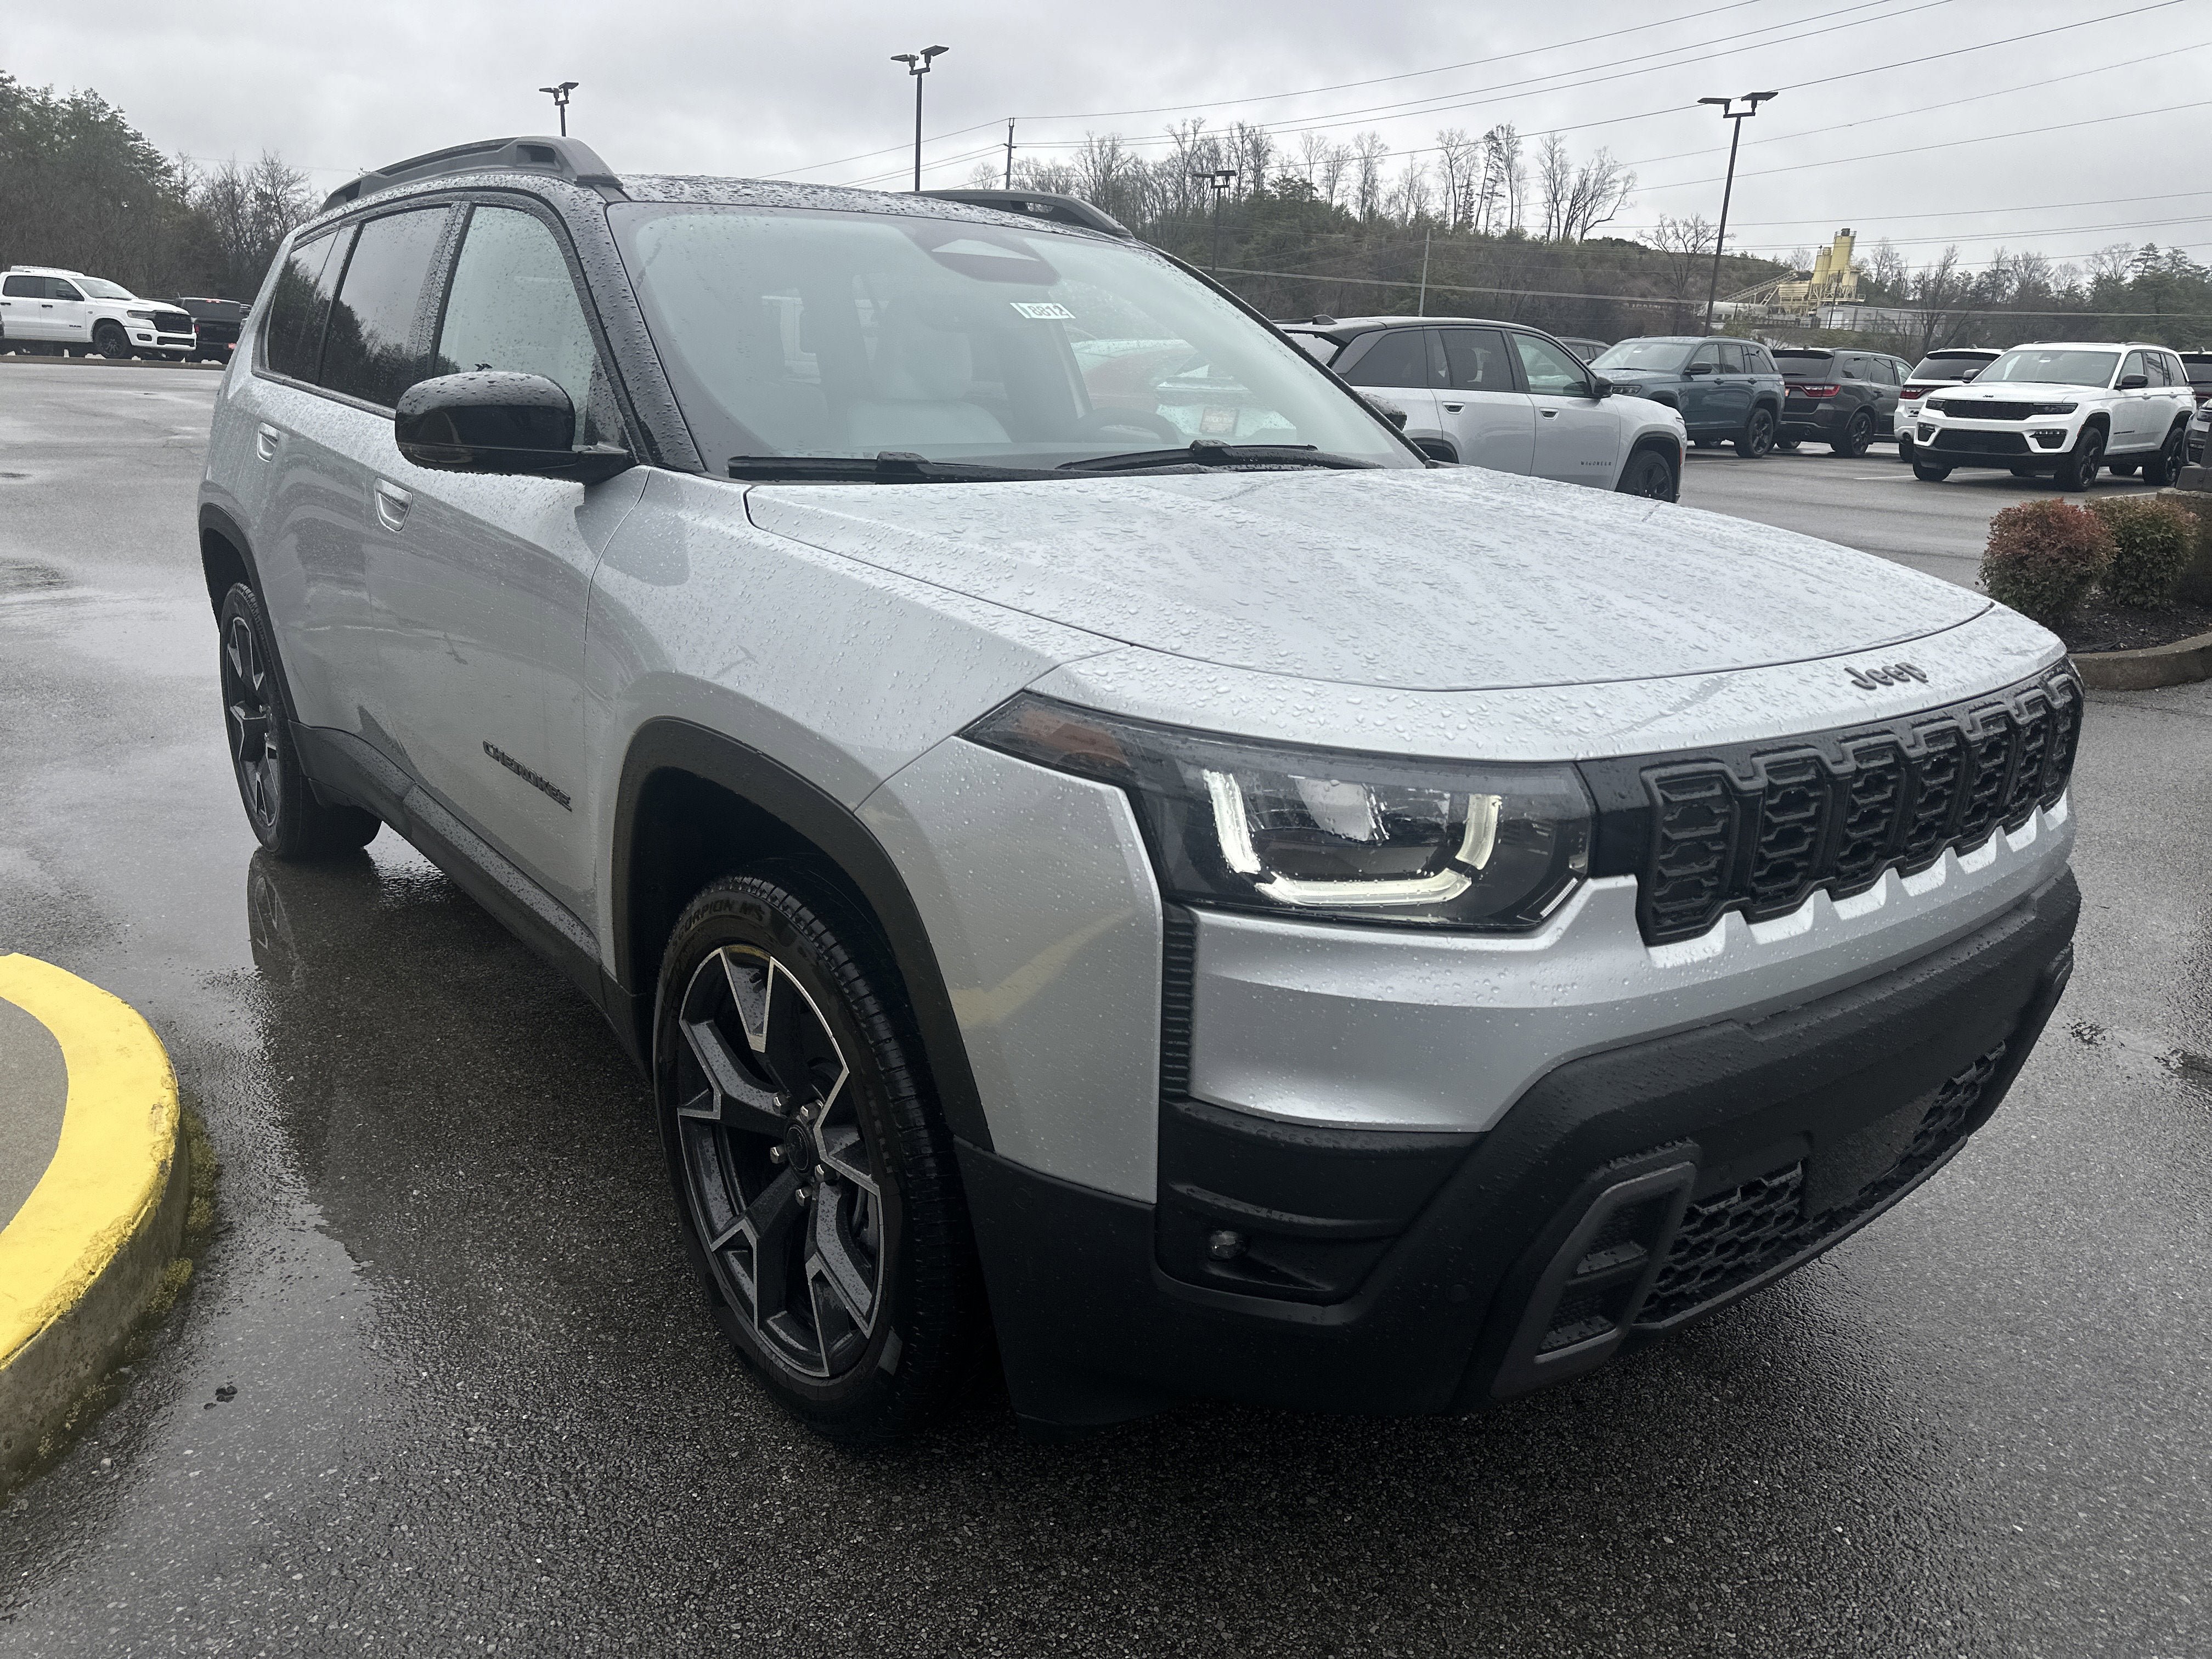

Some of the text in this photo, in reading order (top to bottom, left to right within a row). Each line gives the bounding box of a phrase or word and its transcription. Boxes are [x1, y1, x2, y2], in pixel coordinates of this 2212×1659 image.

[1027, 305, 1069, 317] 8812
[1844, 662, 1928, 690] Jeep
[483, 739, 572, 812] CHEROKEE
